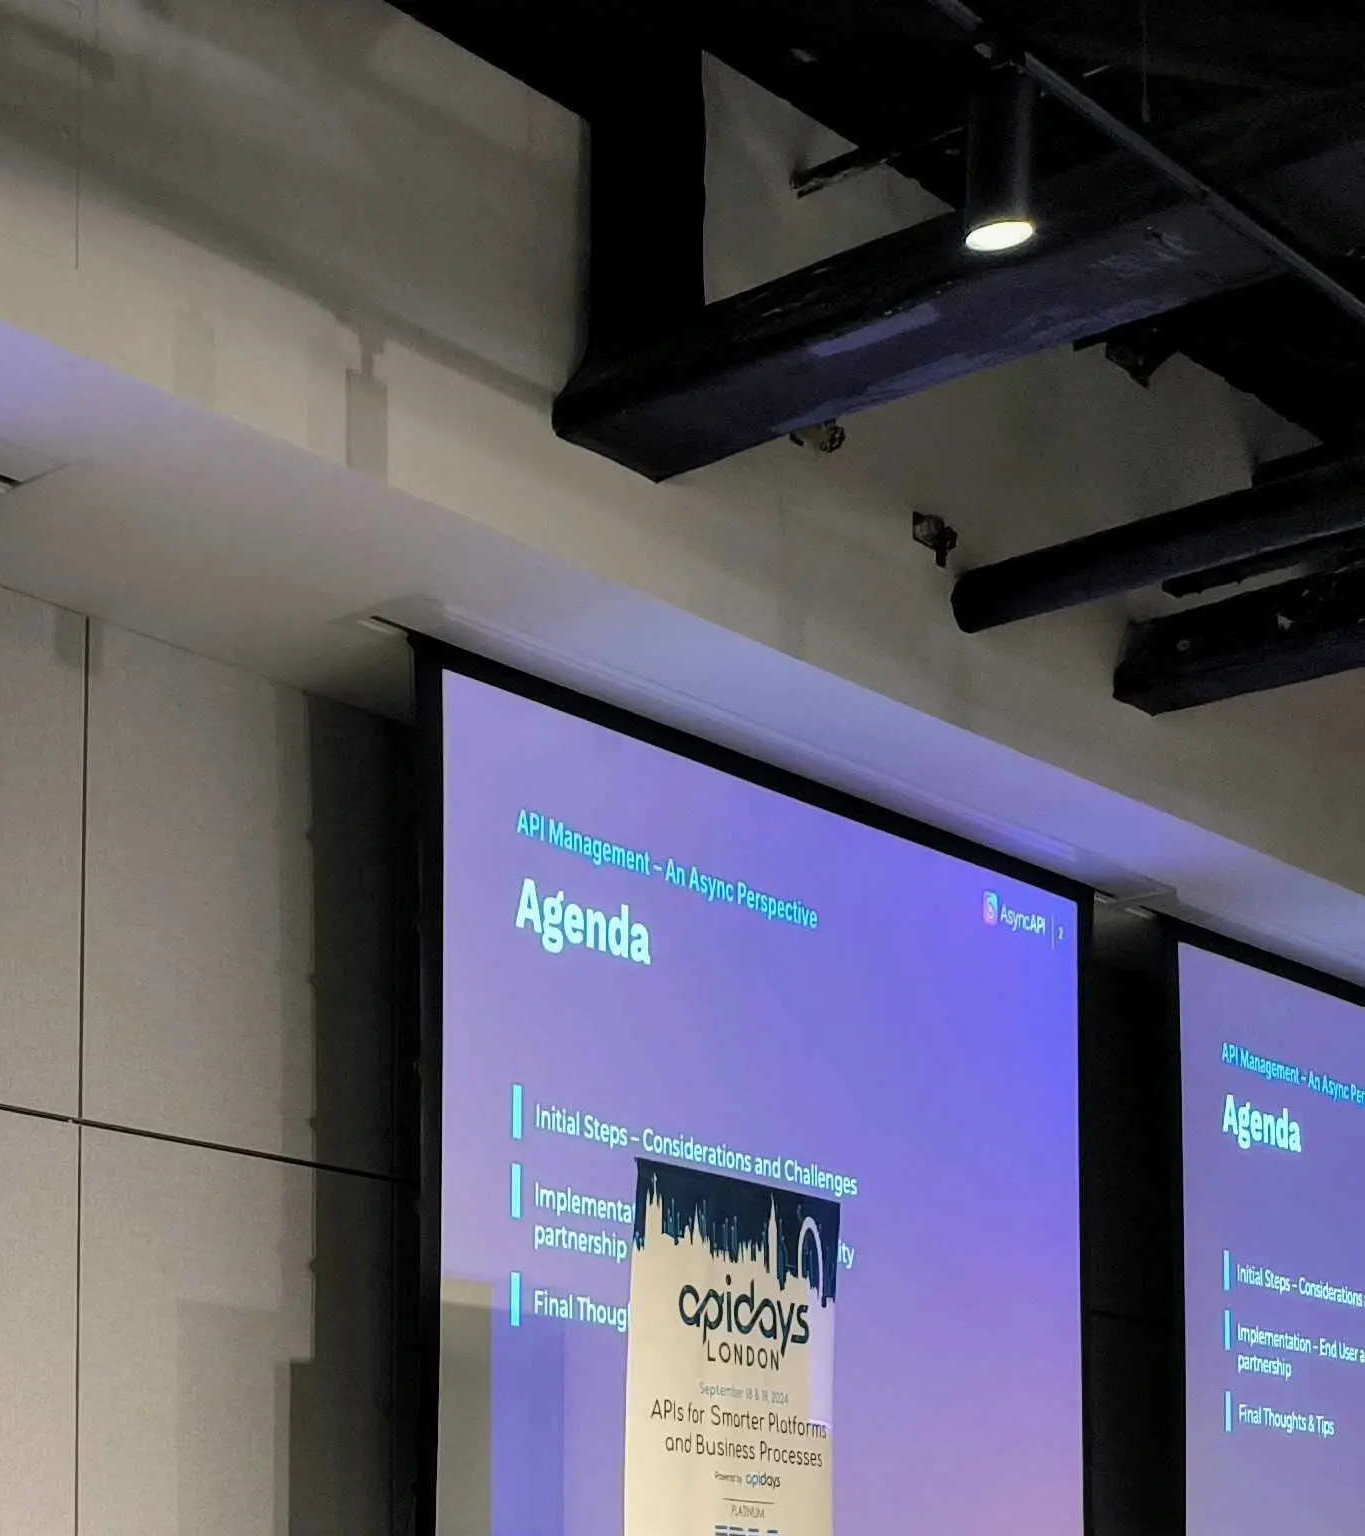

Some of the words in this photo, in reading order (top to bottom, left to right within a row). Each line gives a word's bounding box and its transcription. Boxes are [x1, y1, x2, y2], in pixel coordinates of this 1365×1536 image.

[517, 808, 545, 841] API
[548, 818, 650, 876] Management
[665, 858, 686, 886] An
[689, 866, 734, 902] Async
[737, 881, 818, 929] Perspective
[515, 878, 651, 965] Agenda
[1000, 904, 1046, 935] AsyncAPI
[1222, 1042, 1238, 1065] API
[1240, 1047, 1300, 1084] Management
[1308, 1071, 1320, 1091] An
[1322, 1075, 1349, 1100] Async
[1222, 1094, 1301, 1152] Agenda
[535, 1104, 580, 1136] Initial
[584, 1115, 628, 1148] Steps
[643, 1128, 751, 1172] Considerations
[754, 1157, 781, 1179] and
[784, 1159, 858, 1197] Challenges
[534, 1182, 635, 1225] Implementa
[534, 1223, 628, 1264] partnership
[1237, 1263, 1263, 1286] Initial
[1264, 1269, 1290, 1295] Steps
[1298, 1277, 1363, 1307] Considerations
[534, 1290, 573, 1319] Final
[577, 1295, 628, 1333] Thoug
[678, 1274, 810, 1358] apidays
[707, 1339, 780, 1371] LONDON
[1237, 1323, 1311, 1354] Implementation
[1319, 1338, 1336, 1358] End
[1338, 1341, 1359, 1362] User
[1237, 1353, 1292, 1380] partnership
[651, 1398, 684, 1422] APIs
[688, 1402, 705, 1424] for
[710, 1405, 765, 1431] Smarter
[769, 1411, 827, 1440] Platforms
[1238, 1403, 1262, 1424] Final
[1263, 1407, 1307, 1434] Thoughts
[1308, 1414, 1315, 1432] &
[1316, 1415, 1335, 1438] Tips
[665, 1432, 692, 1453] and
[696, 1434, 756, 1460] Business
[760, 1440, 823, 1467] Processes
[745, 1471, 781, 1490] apidays
[731, 1504, 765, 1519] PLATINUM
